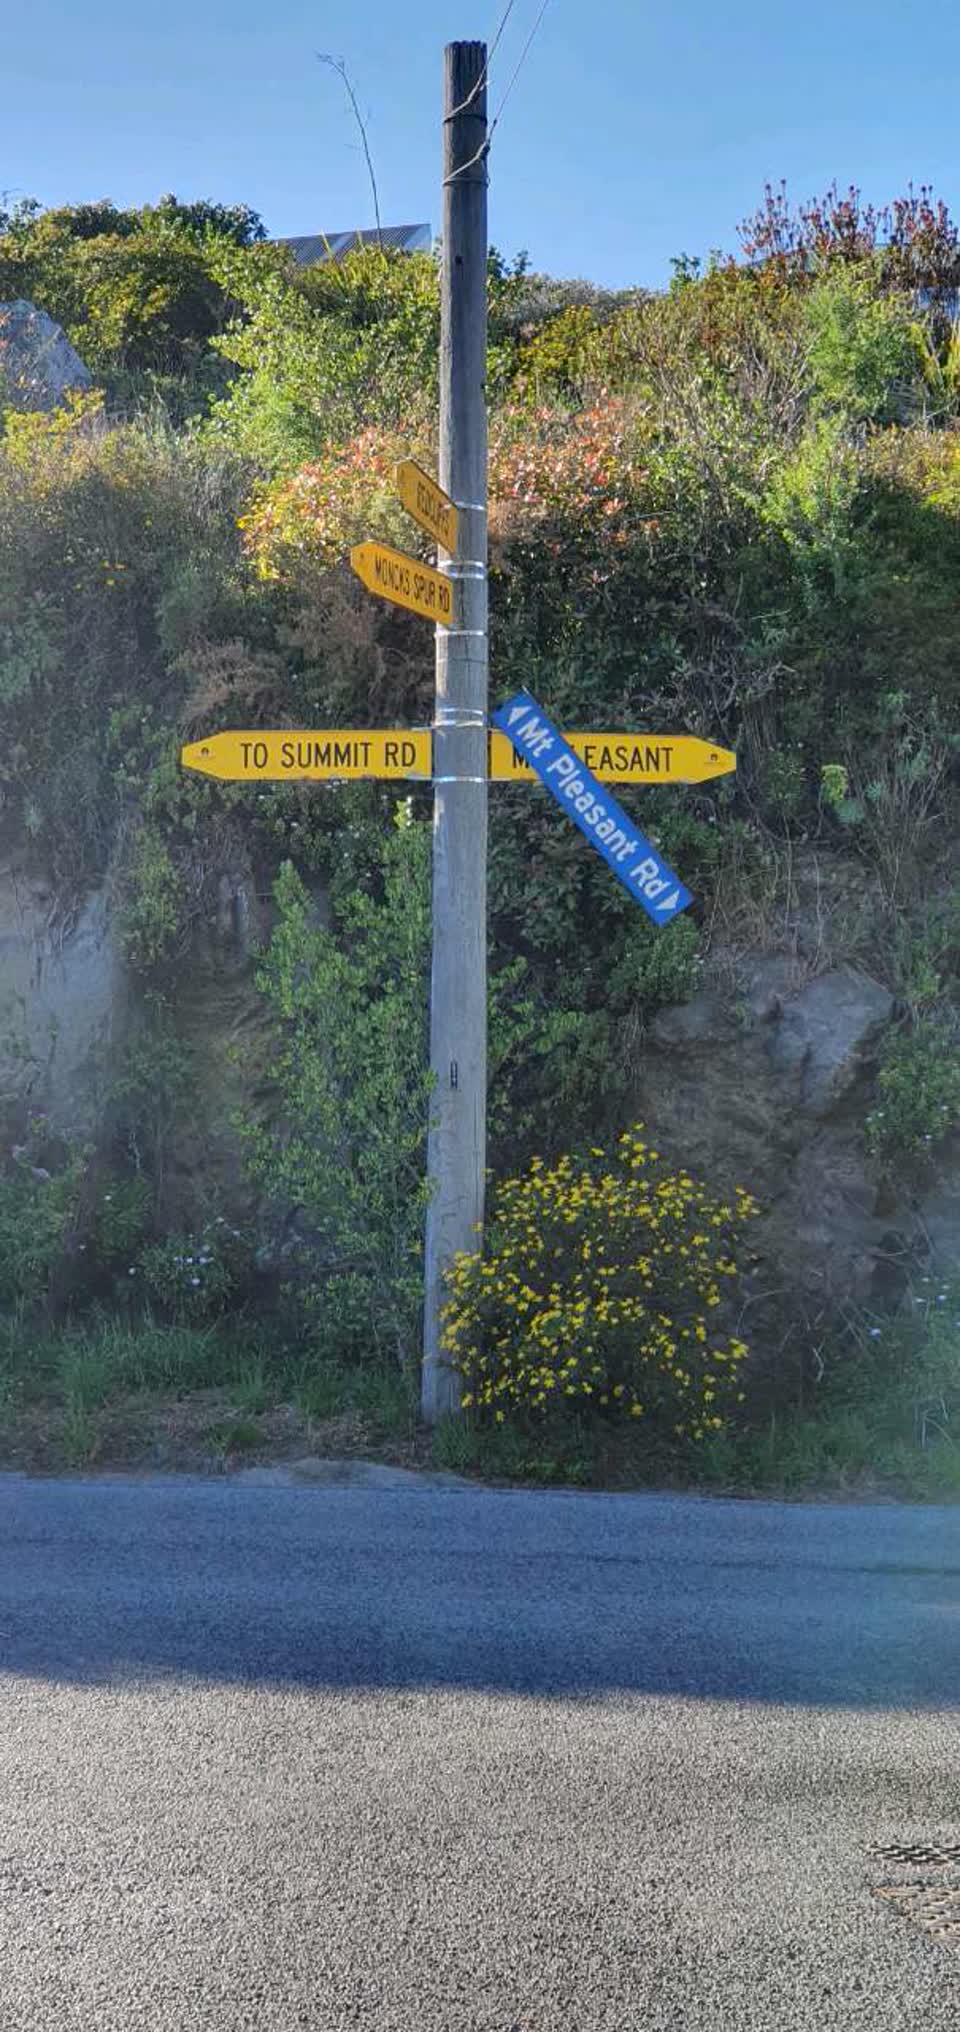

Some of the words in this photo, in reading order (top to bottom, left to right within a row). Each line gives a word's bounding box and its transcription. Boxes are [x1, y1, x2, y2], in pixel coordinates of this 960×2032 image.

[375, 552, 410, 596] MONCKS
[413, 573, 436, 609] SPUR
[439, 585, 450, 613] RD
[240, 742, 269, 769] TO
[281, 741, 372, 769] SUMMIT
[384, 742, 417, 768] RD
[570, 744, 674, 772] EASANT
[516, 717, 556, 758] Mt
[546, 753, 640, 862] Pleasant
[628, 857, 673, 900] Rd
